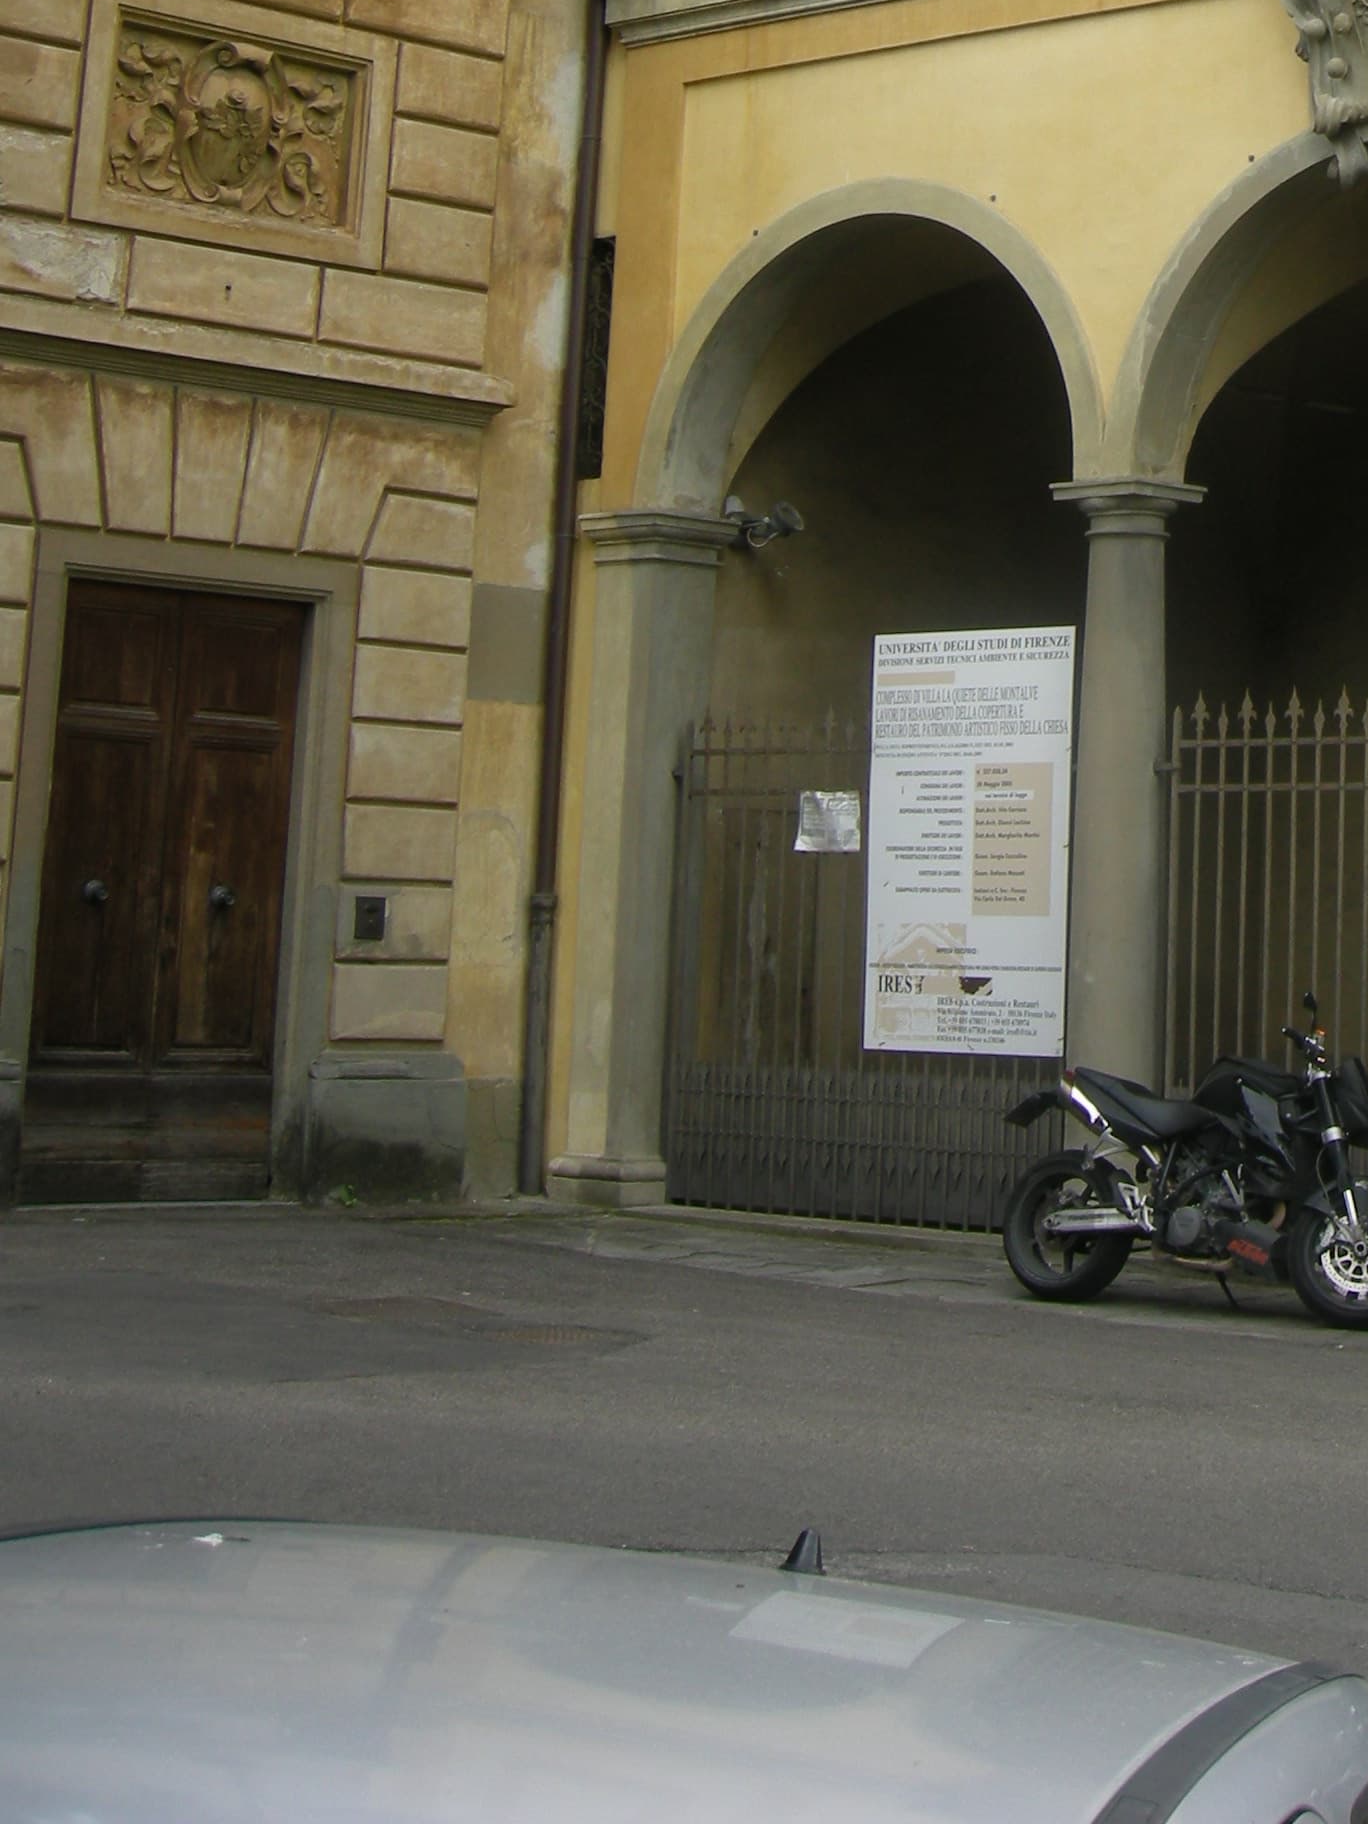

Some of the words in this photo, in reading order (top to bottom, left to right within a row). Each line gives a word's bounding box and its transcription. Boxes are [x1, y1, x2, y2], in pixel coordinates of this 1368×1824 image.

[879, 640, 941, 655] UNIVERSITA'
[943, 639, 975, 652] DEGLI
[977, 637, 1008, 651] STUDI
[1010, 637, 1022, 649] DI
[1024, 635, 1070, 649] FIRENZE
[1025, 650, 1070, 661] SICUREZZA
[878, 974, 913, 993] IRES
